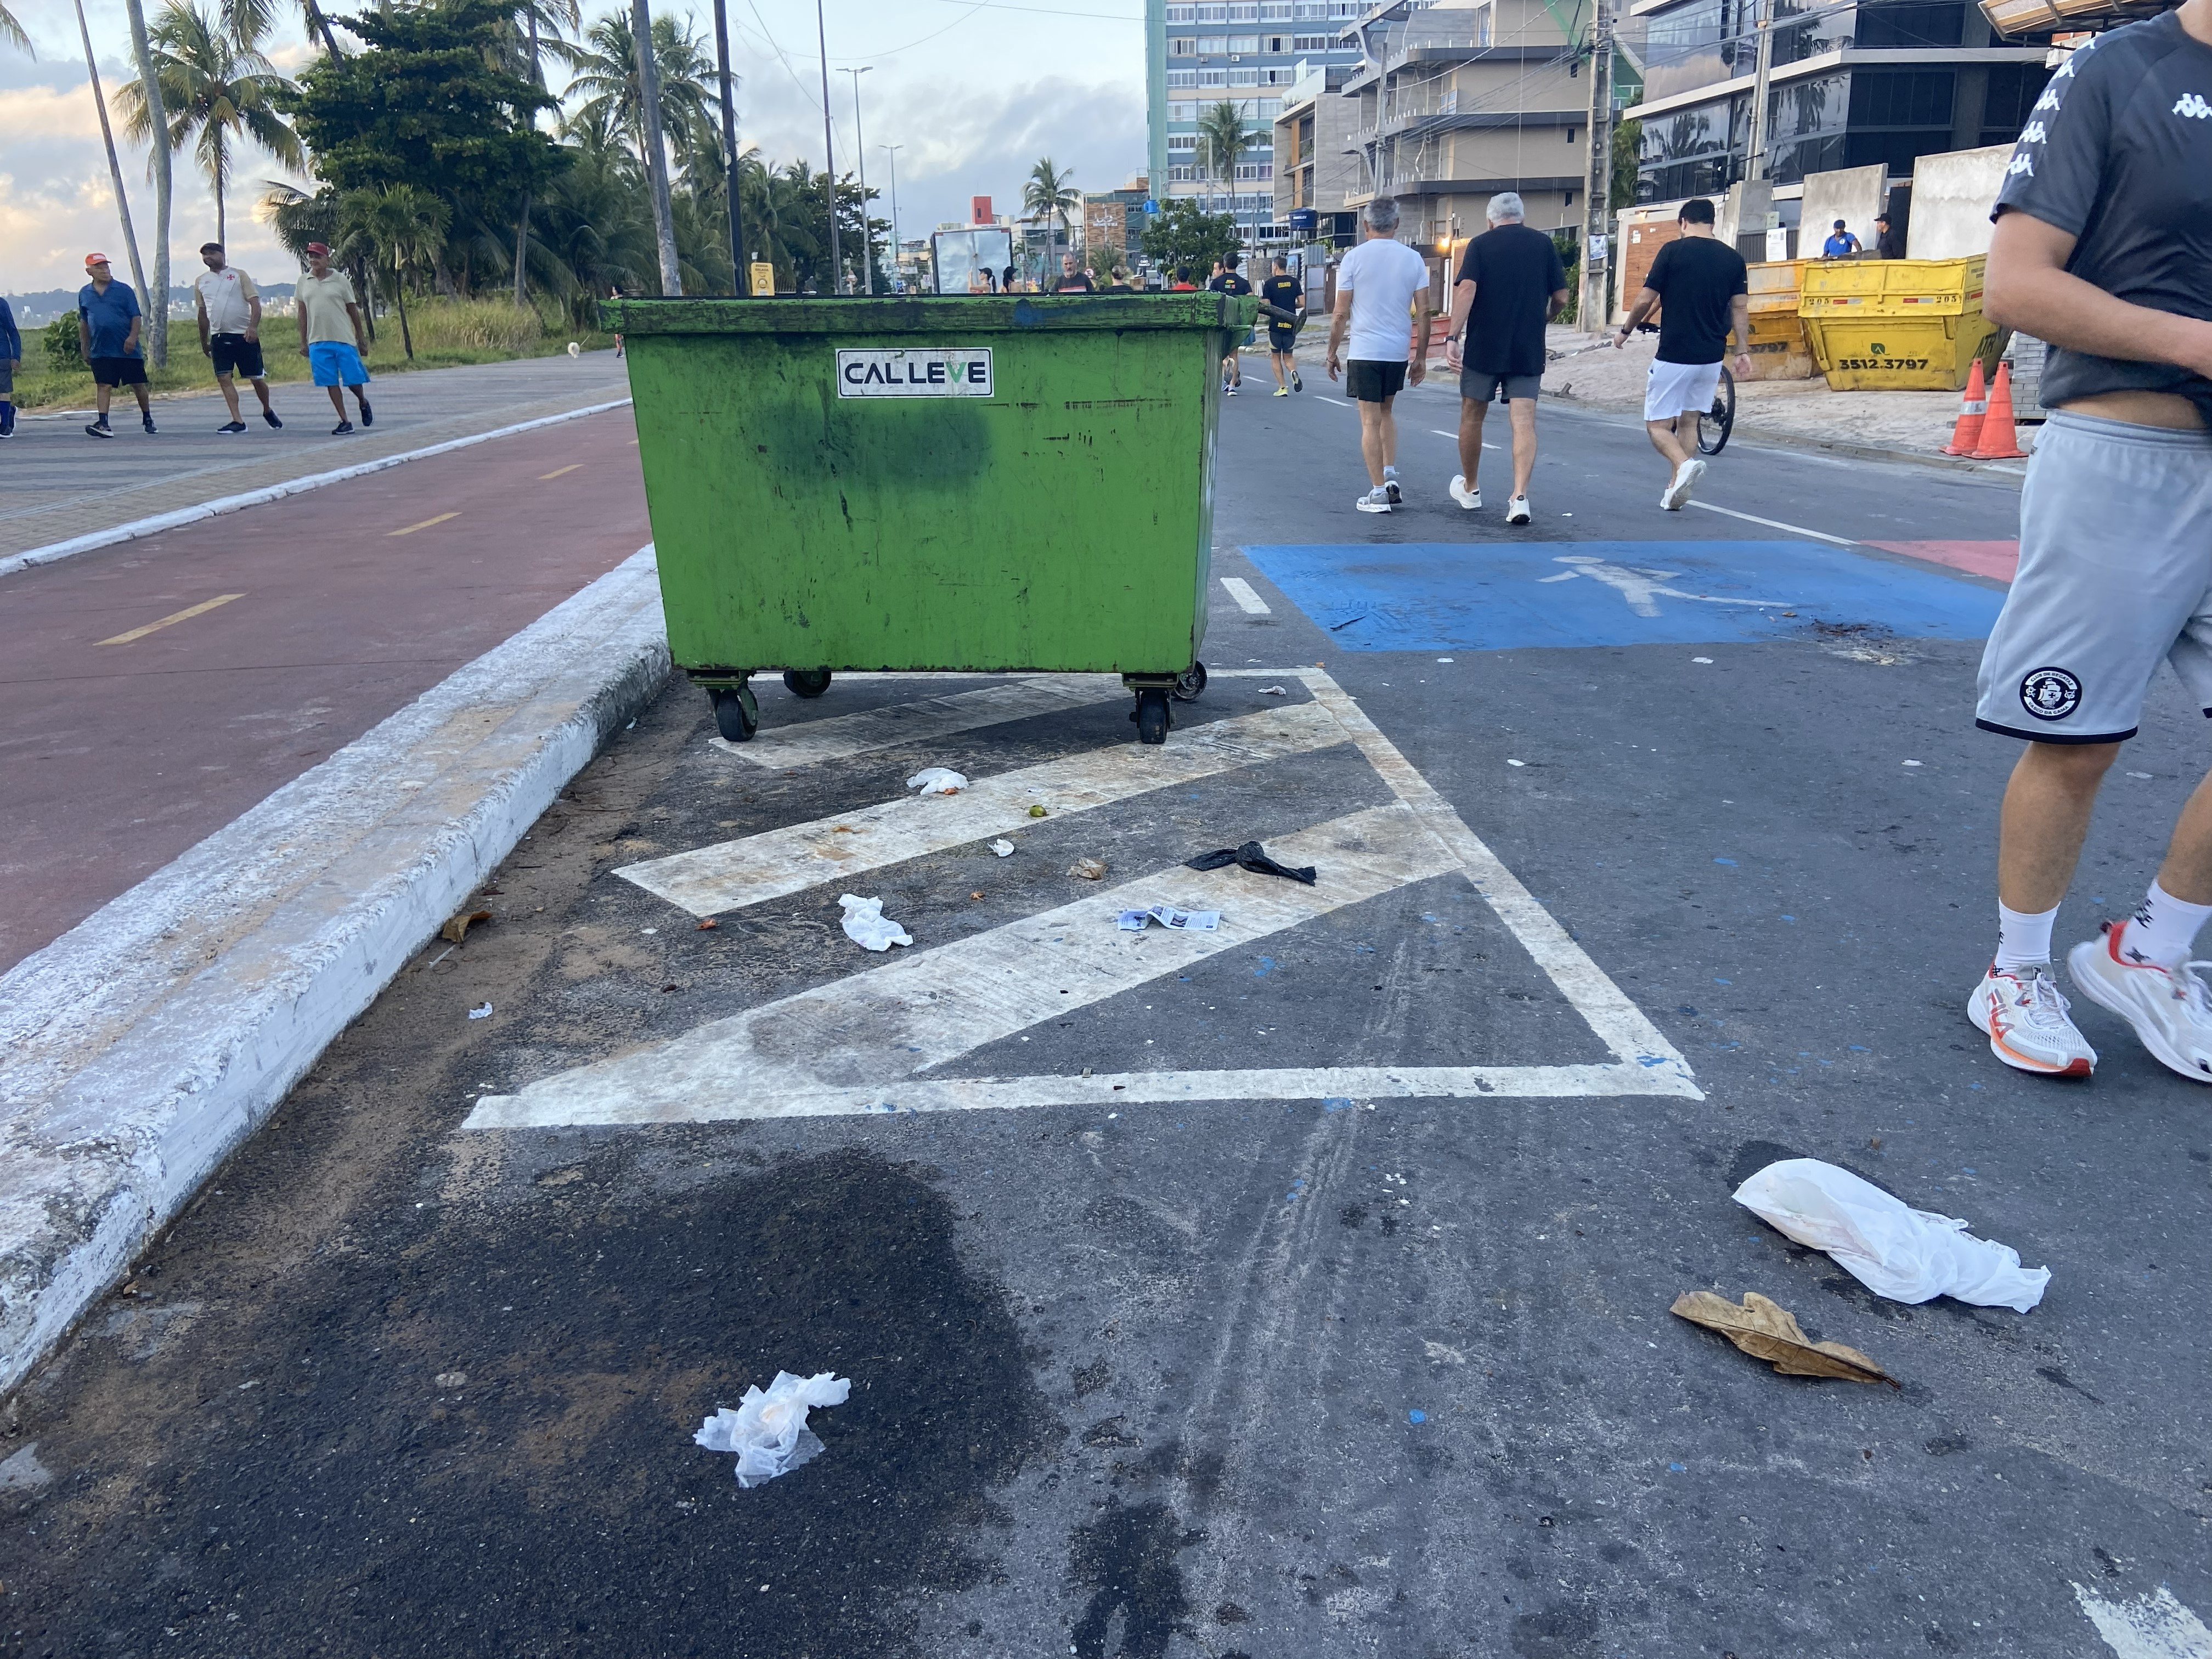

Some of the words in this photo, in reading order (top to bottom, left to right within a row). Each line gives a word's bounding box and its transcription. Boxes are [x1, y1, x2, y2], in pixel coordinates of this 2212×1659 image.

[1809, 297, 1830, 306] 205
[1936, 295, 1957, 303] 205
[1839, 358, 1929, 370] 3512.3797
[909, 362, 986, 383] LEVE
[2030, 673, 2042, 682] CLUB
[2051, 672, 2073, 686] REGATAS
[2028, 701, 2044, 713] VASCO
[2053, 706, 2069, 714] GAMA
